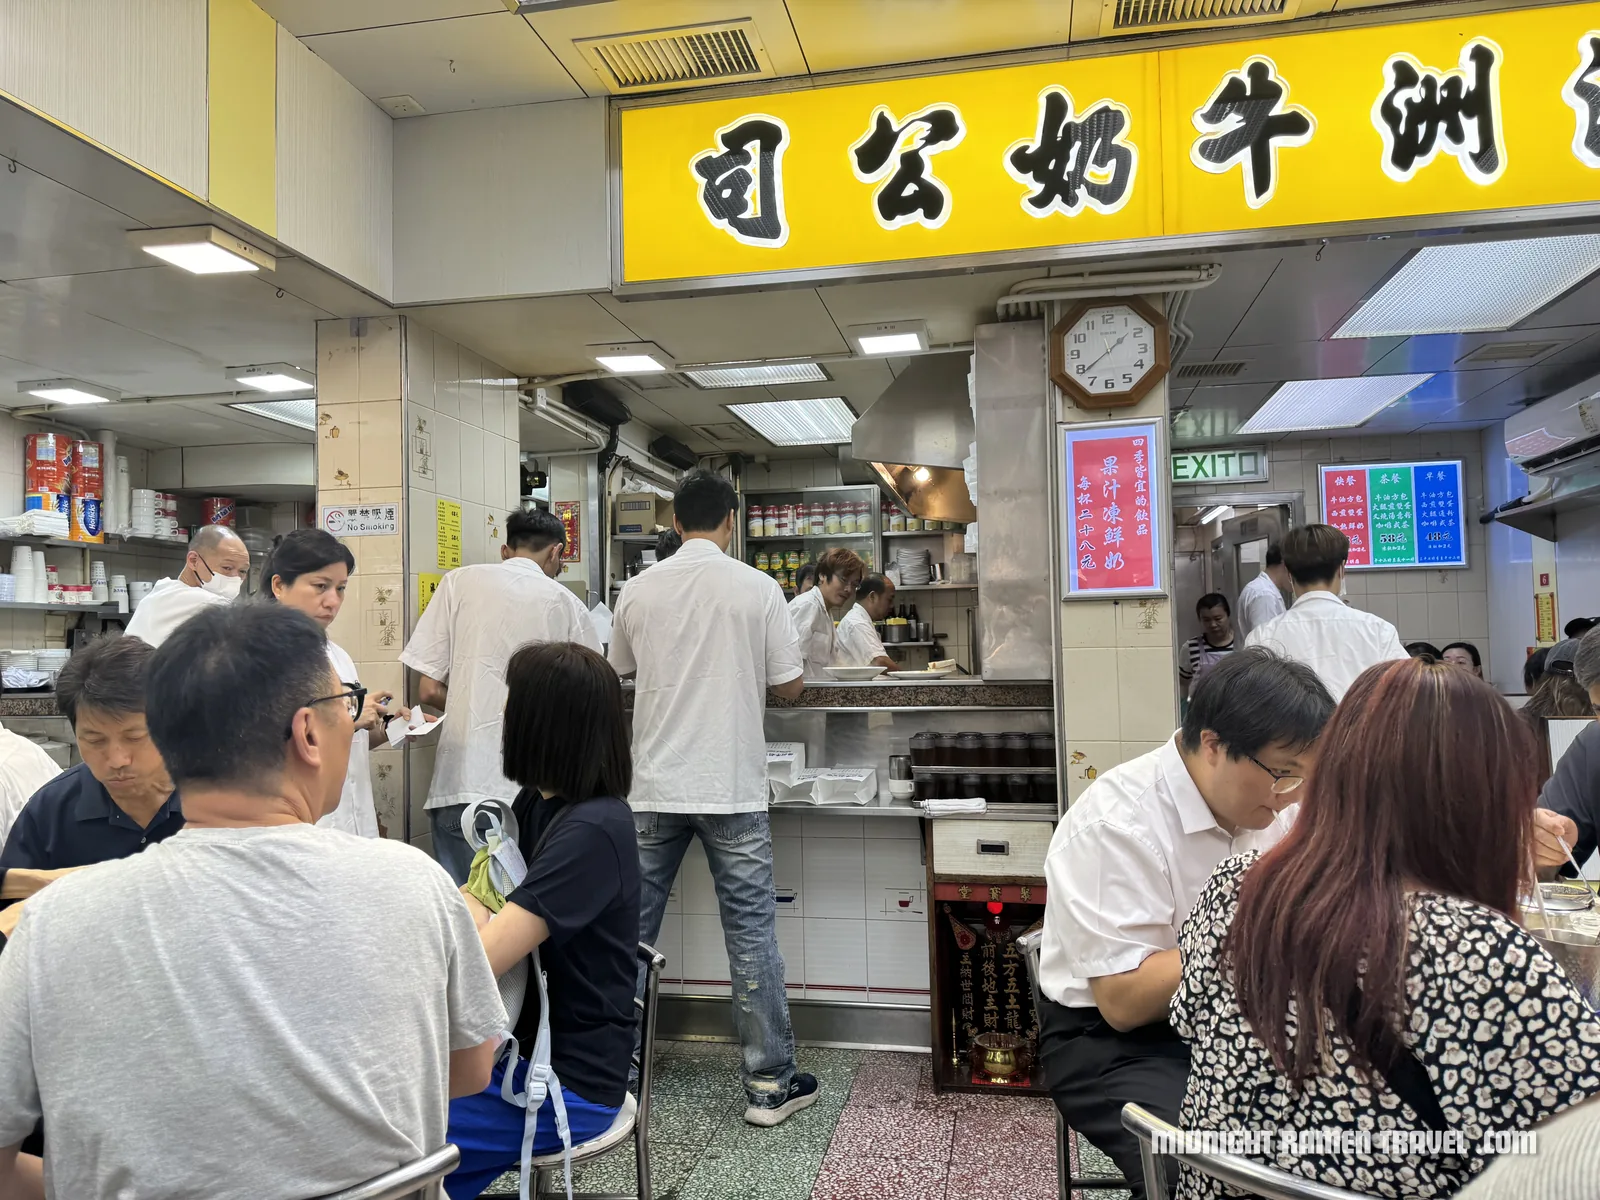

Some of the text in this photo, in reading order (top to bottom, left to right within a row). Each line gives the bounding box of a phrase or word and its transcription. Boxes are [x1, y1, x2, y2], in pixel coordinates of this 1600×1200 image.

[1101, 314, 1114, 324] 12
[1124, 317, 1128, 327] 1
[1086, 320, 1094, 330] 11
[1133, 328, 1143, 338] 2
[1074, 333, 1086, 344] 10
[1138, 343, 1148, 354] 3
[1070, 350, 1080, 360] 9
[1076, 364, 1086, 374] 8
[1134, 359, 1144, 369] 4
[1088, 376, 1097, 386] 7
[1105, 379, 1114, 388] 6
[1122, 374, 1132, 383] 5
[1172, 453, 1236, 480] EXIT
[1380, 473, 1402, 484] 茶餐
[1425, 470, 1446, 481] 早餐
[1335, 476, 1356, 486] 快餐
[1132, 438, 1150, 536] 四季皆宜的飲品
[1331, 495, 1363, 504] 牛油方包
[1375, 493, 1408, 502] 牛油方包
[1420, 490, 1454, 500] 牛油方包
[360, 524, 395, 532] Smoking
[1076, 476, 1096, 570] 每杯二十八元
[1380, 532, 1407, 543] 58元
[1425, 532, 1453, 541] 48元
[980, 943, 999, 1033] 前後地主財
[1002, 942, 1022, 1036] 五方五土龍
